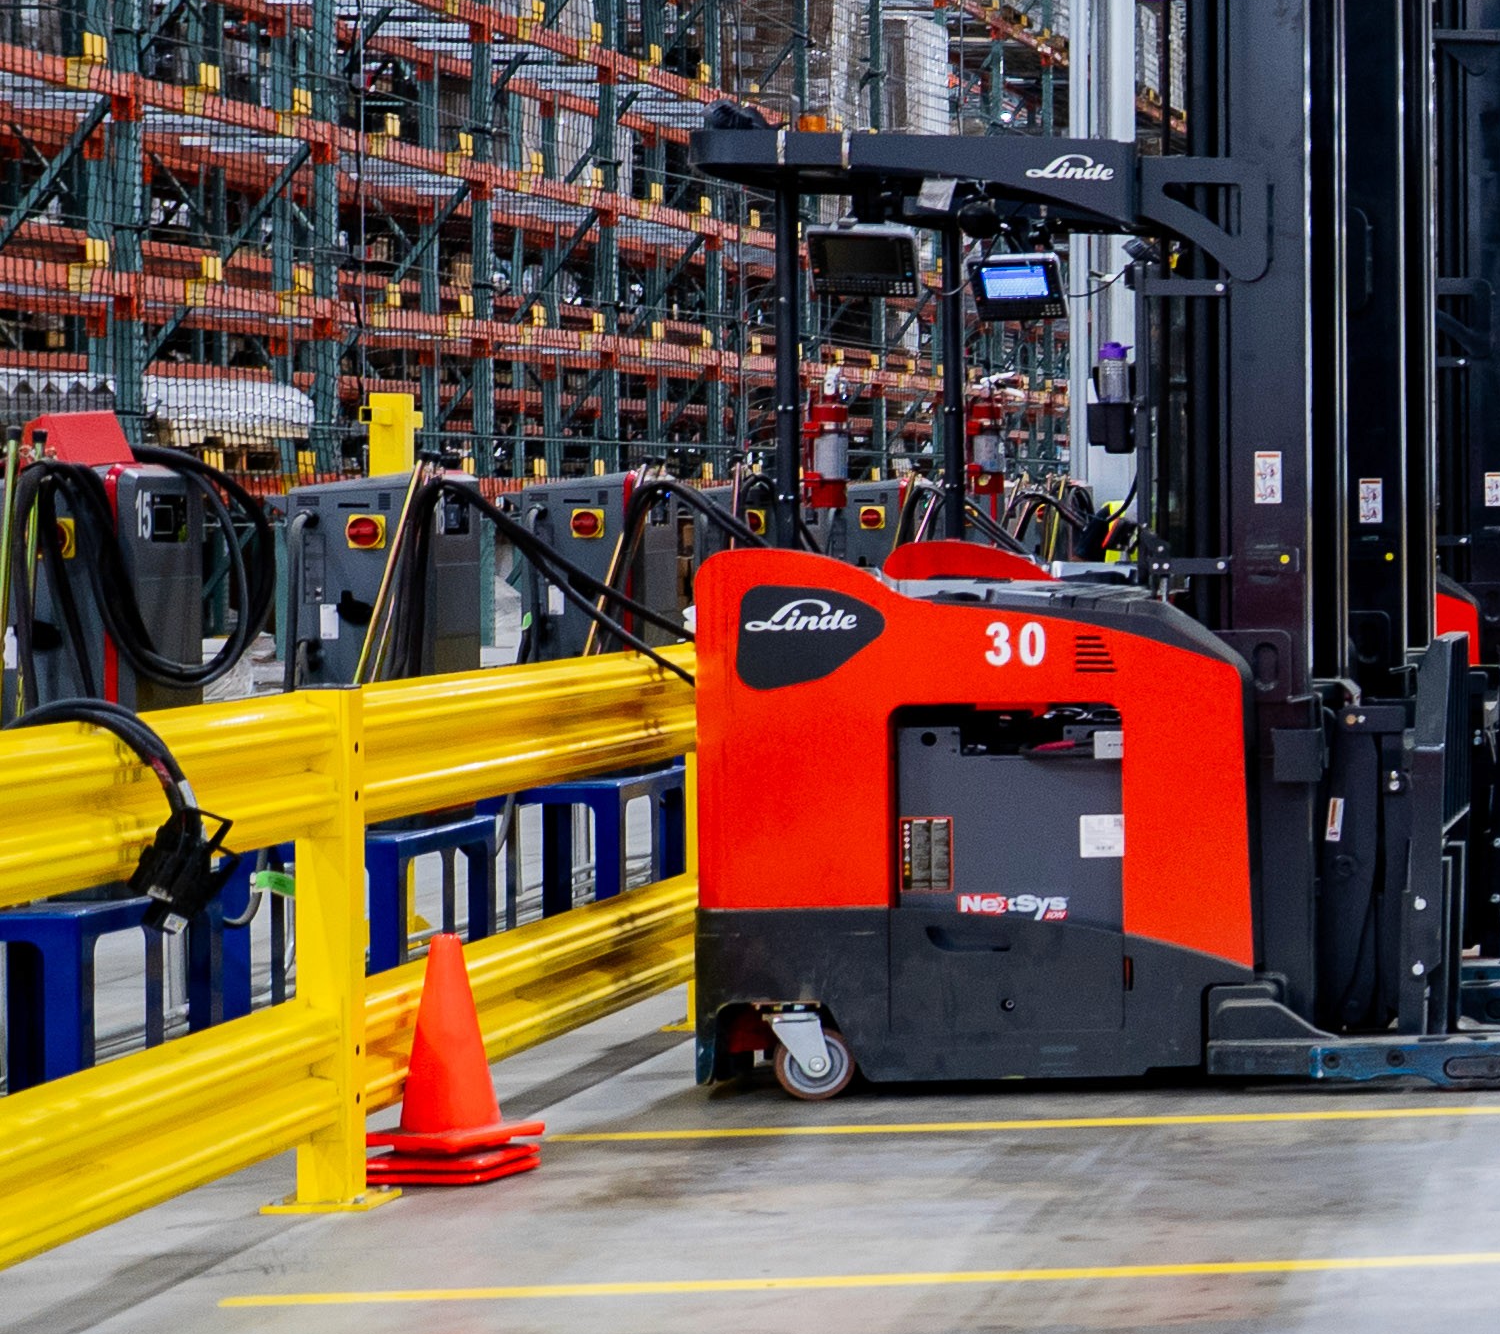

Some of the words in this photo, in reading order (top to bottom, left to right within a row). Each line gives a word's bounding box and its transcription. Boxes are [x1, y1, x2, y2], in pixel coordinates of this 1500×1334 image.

[1025, 154, 1114, 181] Linde
[135, 489, 152, 540] 15
[745, 599, 858, 632] Linde
[984, 621, 1046, 667] 30
